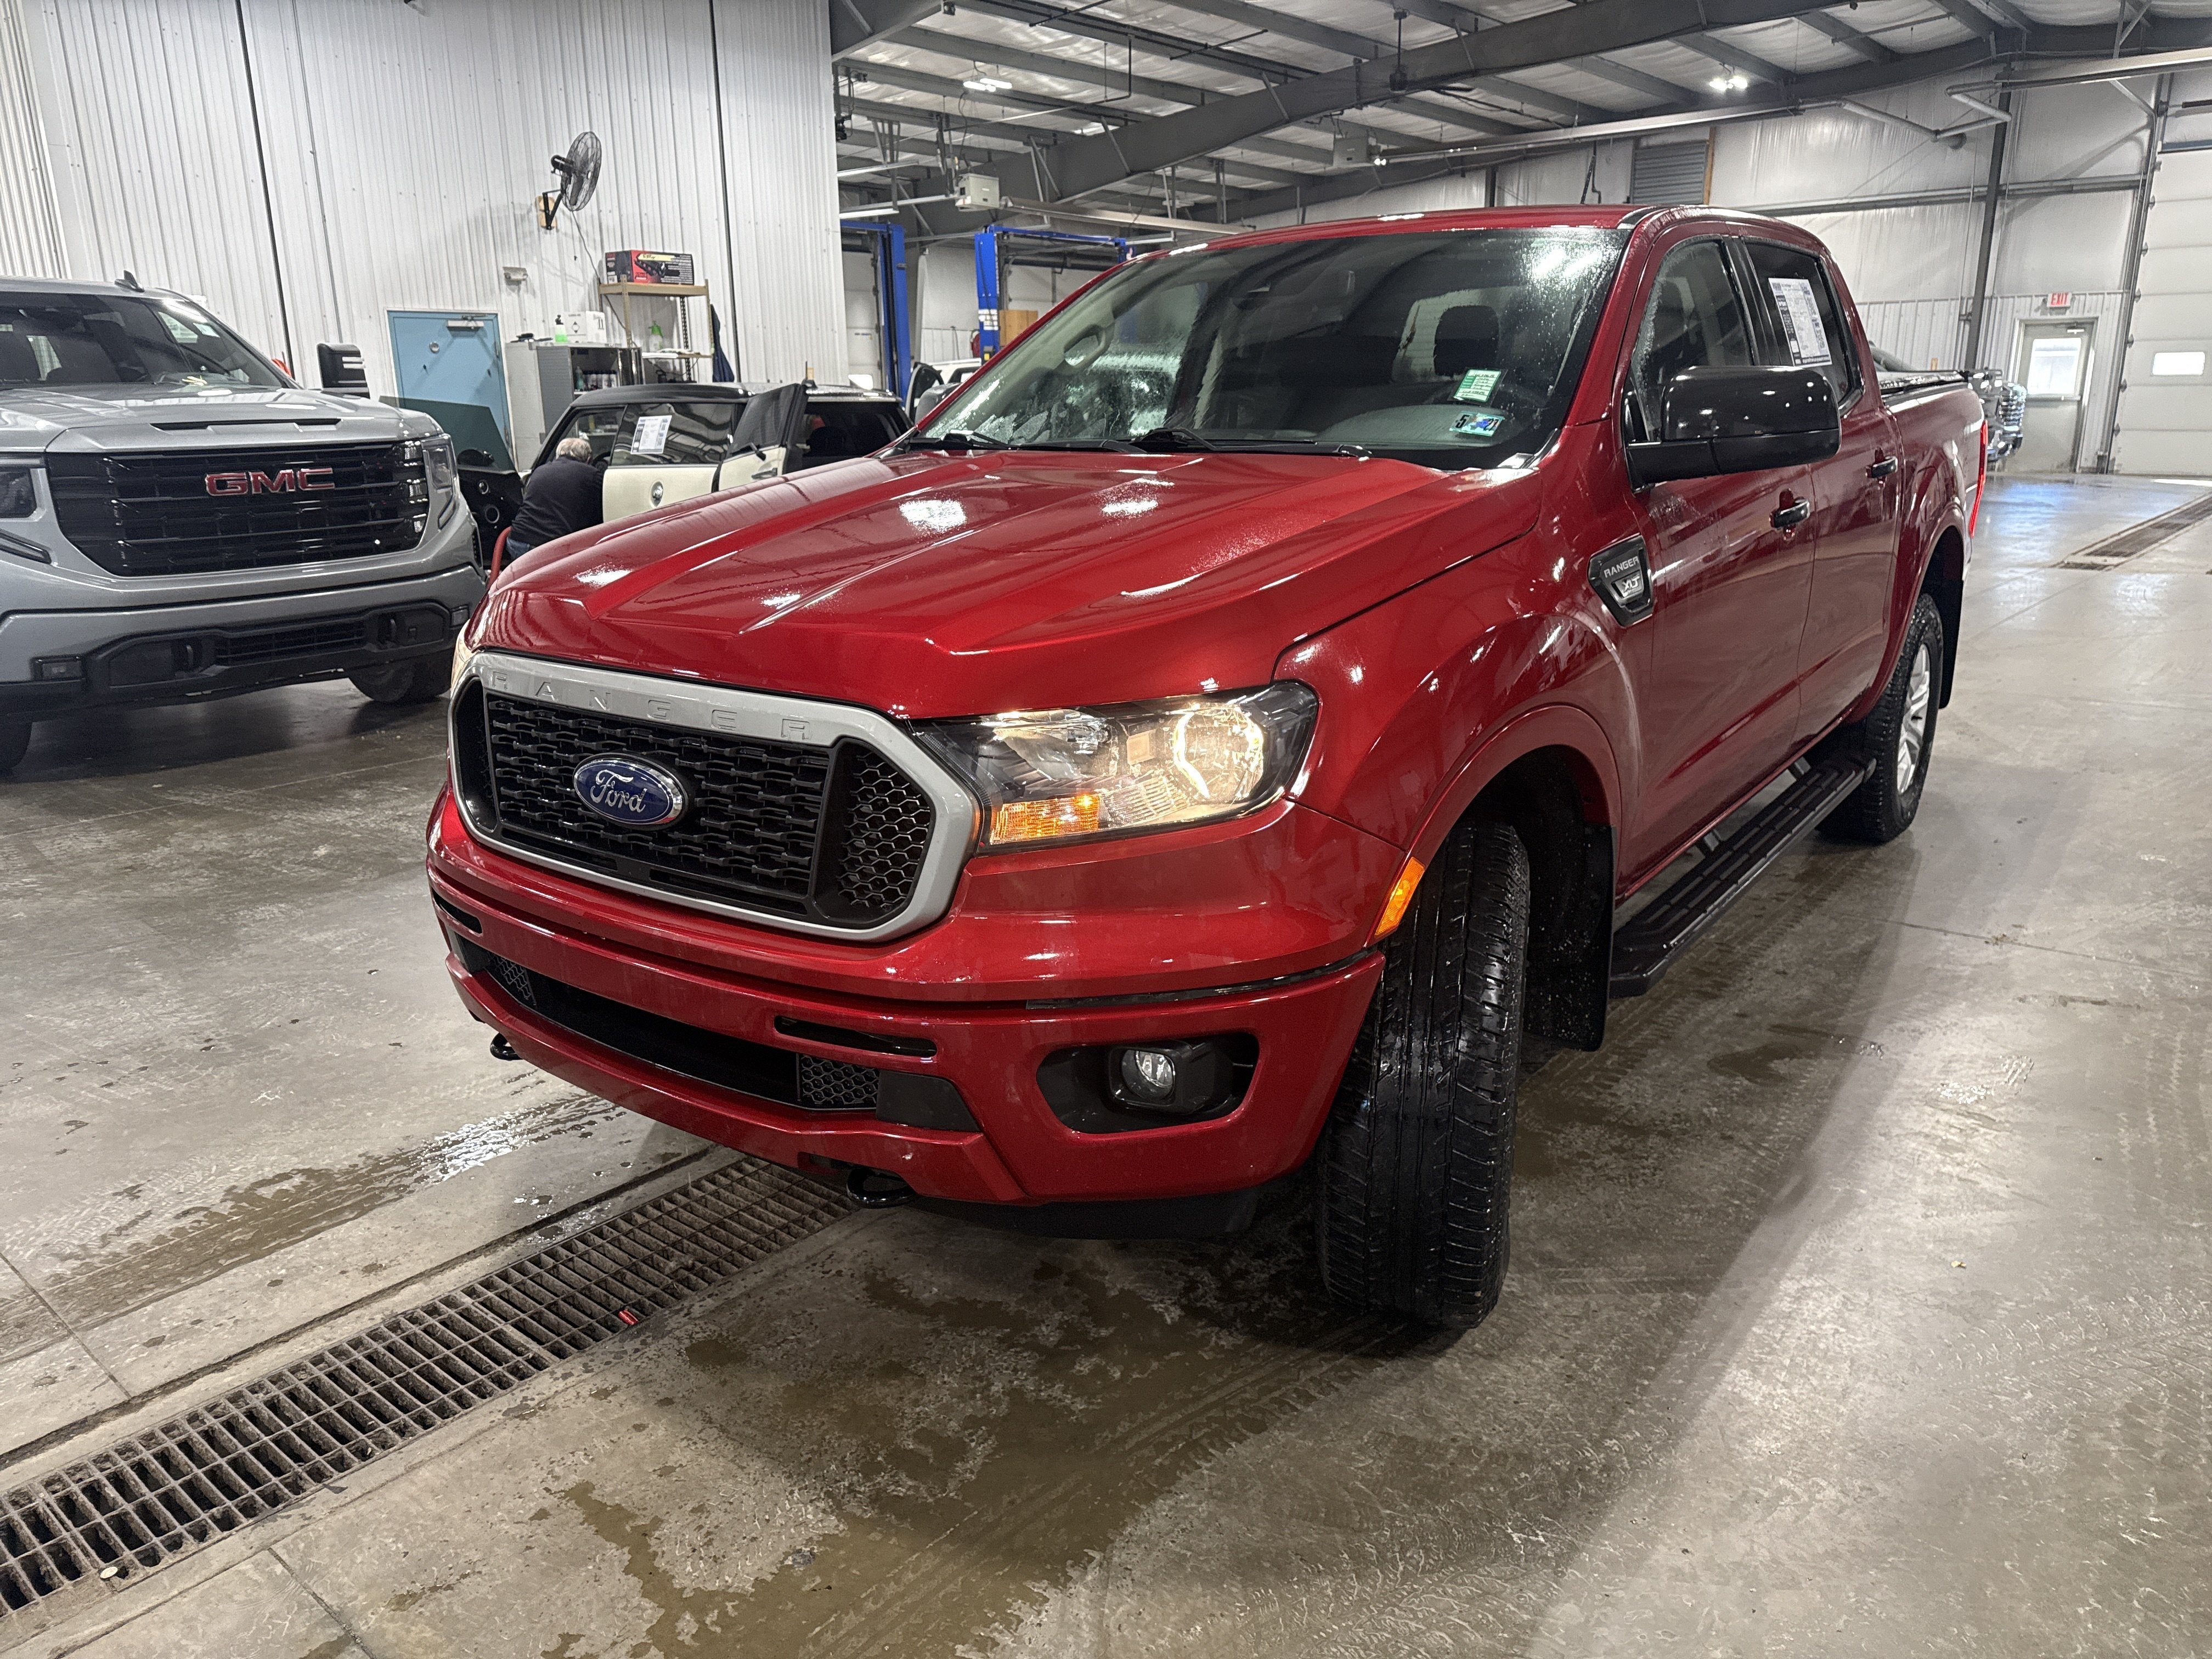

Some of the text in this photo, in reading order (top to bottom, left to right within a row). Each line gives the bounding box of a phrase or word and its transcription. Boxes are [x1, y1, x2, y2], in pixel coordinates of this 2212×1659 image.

[2051, 292, 2068, 305] EXIT
[1455, 415, 1470, 428] 5
[206, 467, 335, 496] GMC
[1604, 556, 1639, 578] RANGER
[1622, 575, 1640, 592] XLT
[490, 670, 811, 742] RANGER
[590, 769, 648, 813] Ford
